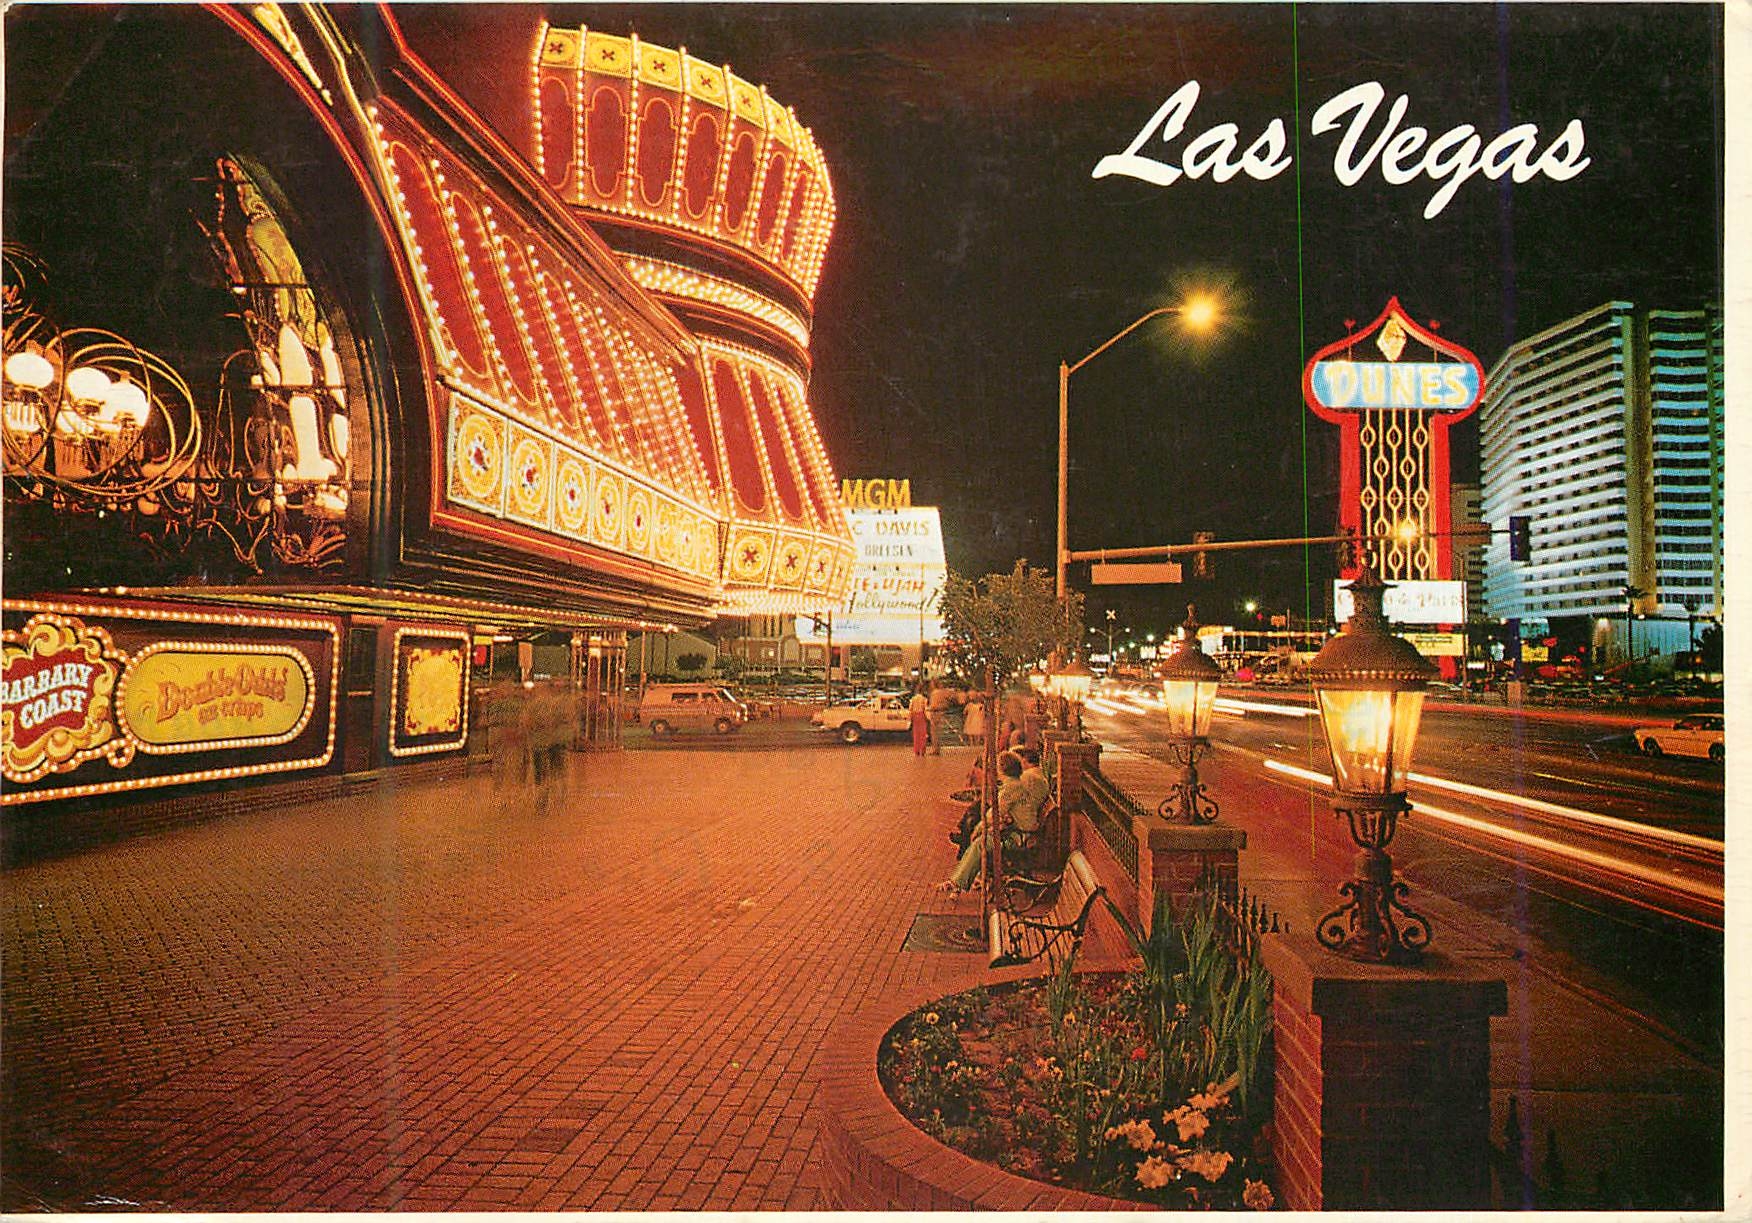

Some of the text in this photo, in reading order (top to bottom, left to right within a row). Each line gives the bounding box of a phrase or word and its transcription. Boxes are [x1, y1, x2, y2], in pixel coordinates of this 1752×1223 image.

[1324, 360, 1469, 407] DUNES
[840, 479, 911, 508] MGM
[876, 520, 929, 536] DAVIS
[1, 663, 93, 704] BARBARY
[20, 690, 87, 729] COAST
